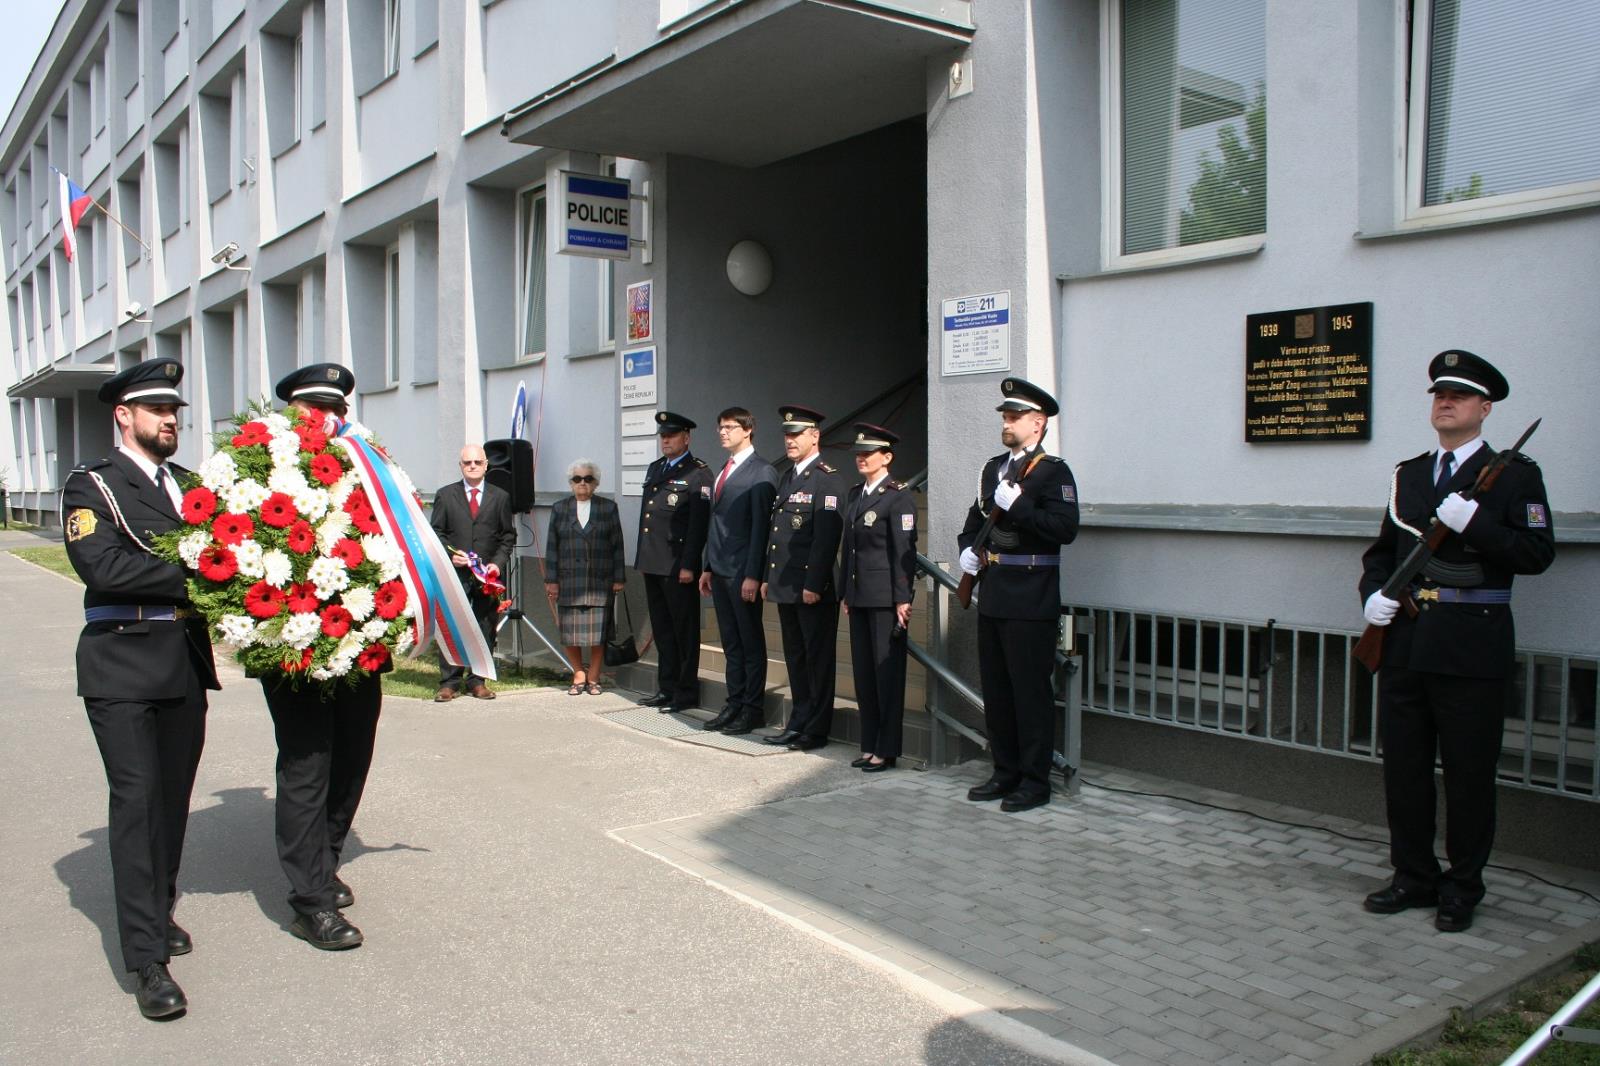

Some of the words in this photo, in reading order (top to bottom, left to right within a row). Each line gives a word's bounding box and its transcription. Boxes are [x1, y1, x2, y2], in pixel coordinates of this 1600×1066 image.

[567, 202, 628, 226] POLICIE
[980, 297, 995, 311] 211
[1332, 315, 1353, 331] 1945
[1260, 324, 1279, 338] 1939
[1269, 380, 1285, 391] Josef
